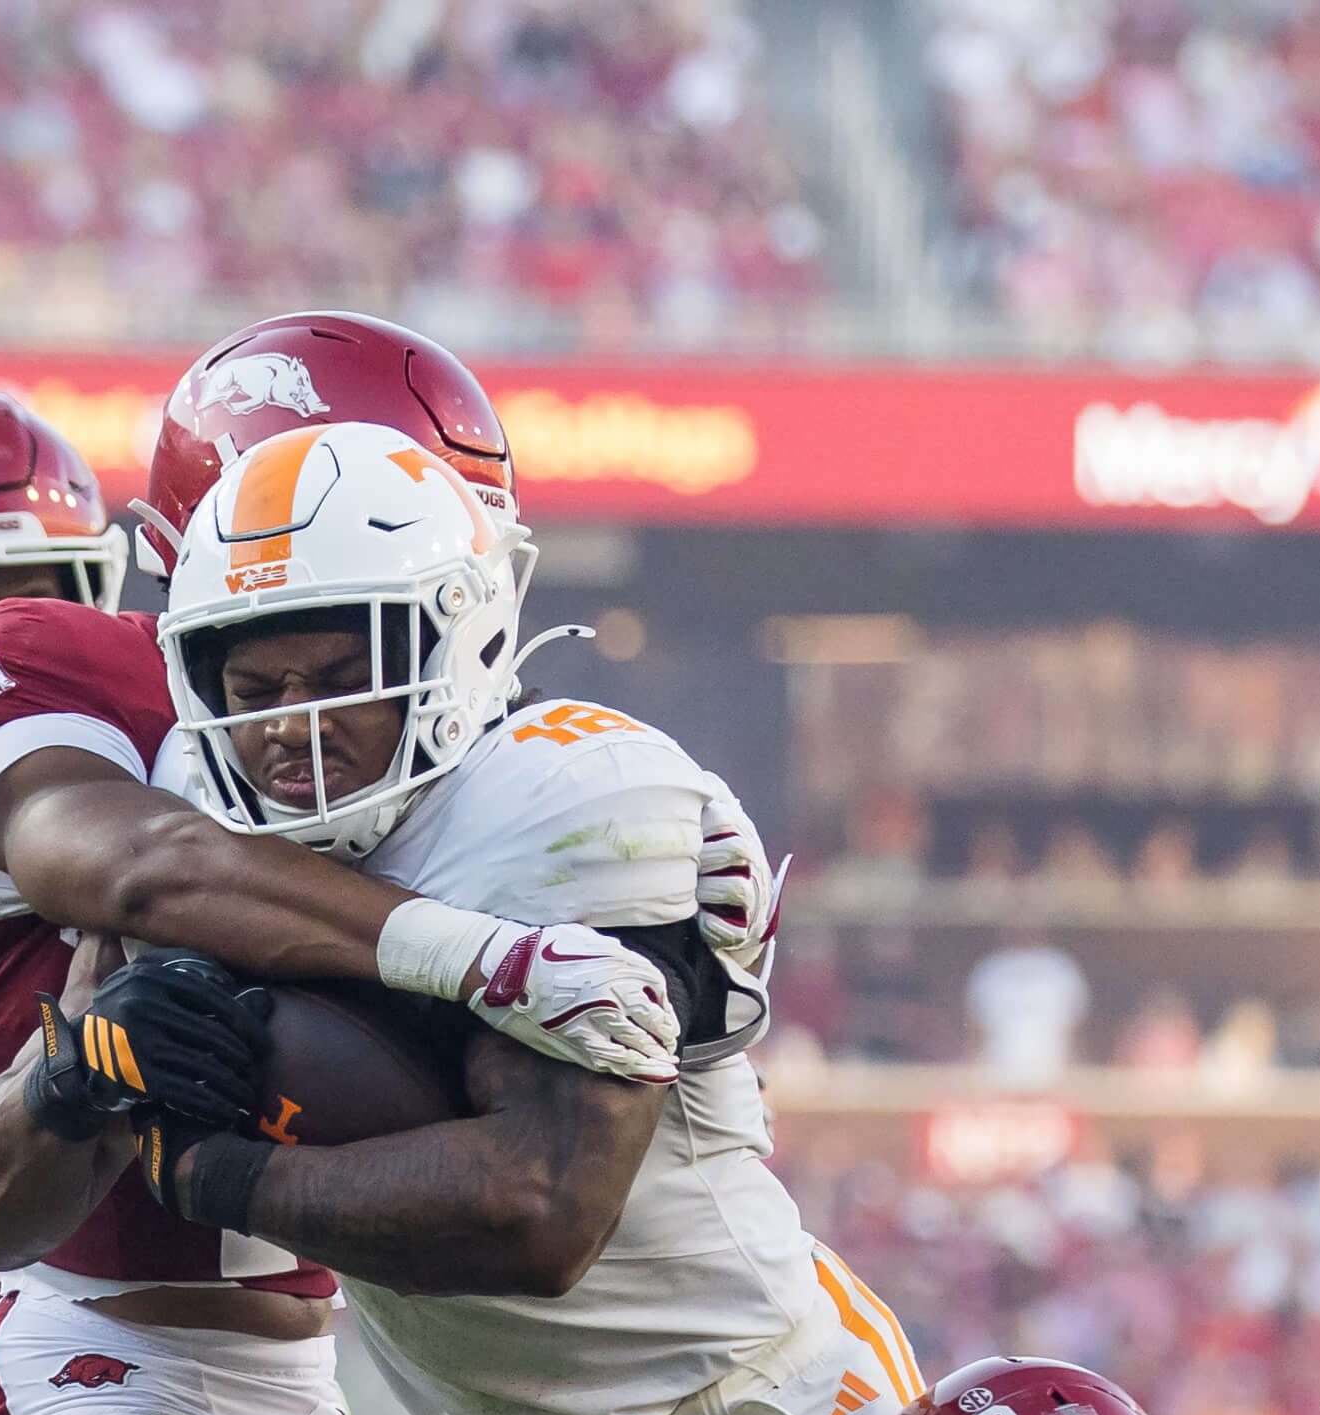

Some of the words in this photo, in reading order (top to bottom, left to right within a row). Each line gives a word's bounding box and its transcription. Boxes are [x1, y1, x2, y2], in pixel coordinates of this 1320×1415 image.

[475, 488, 506, 509] OGS
[40, 1002, 58, 1057] ADIZERO
[961, 1387, 993, 1411] SEC
